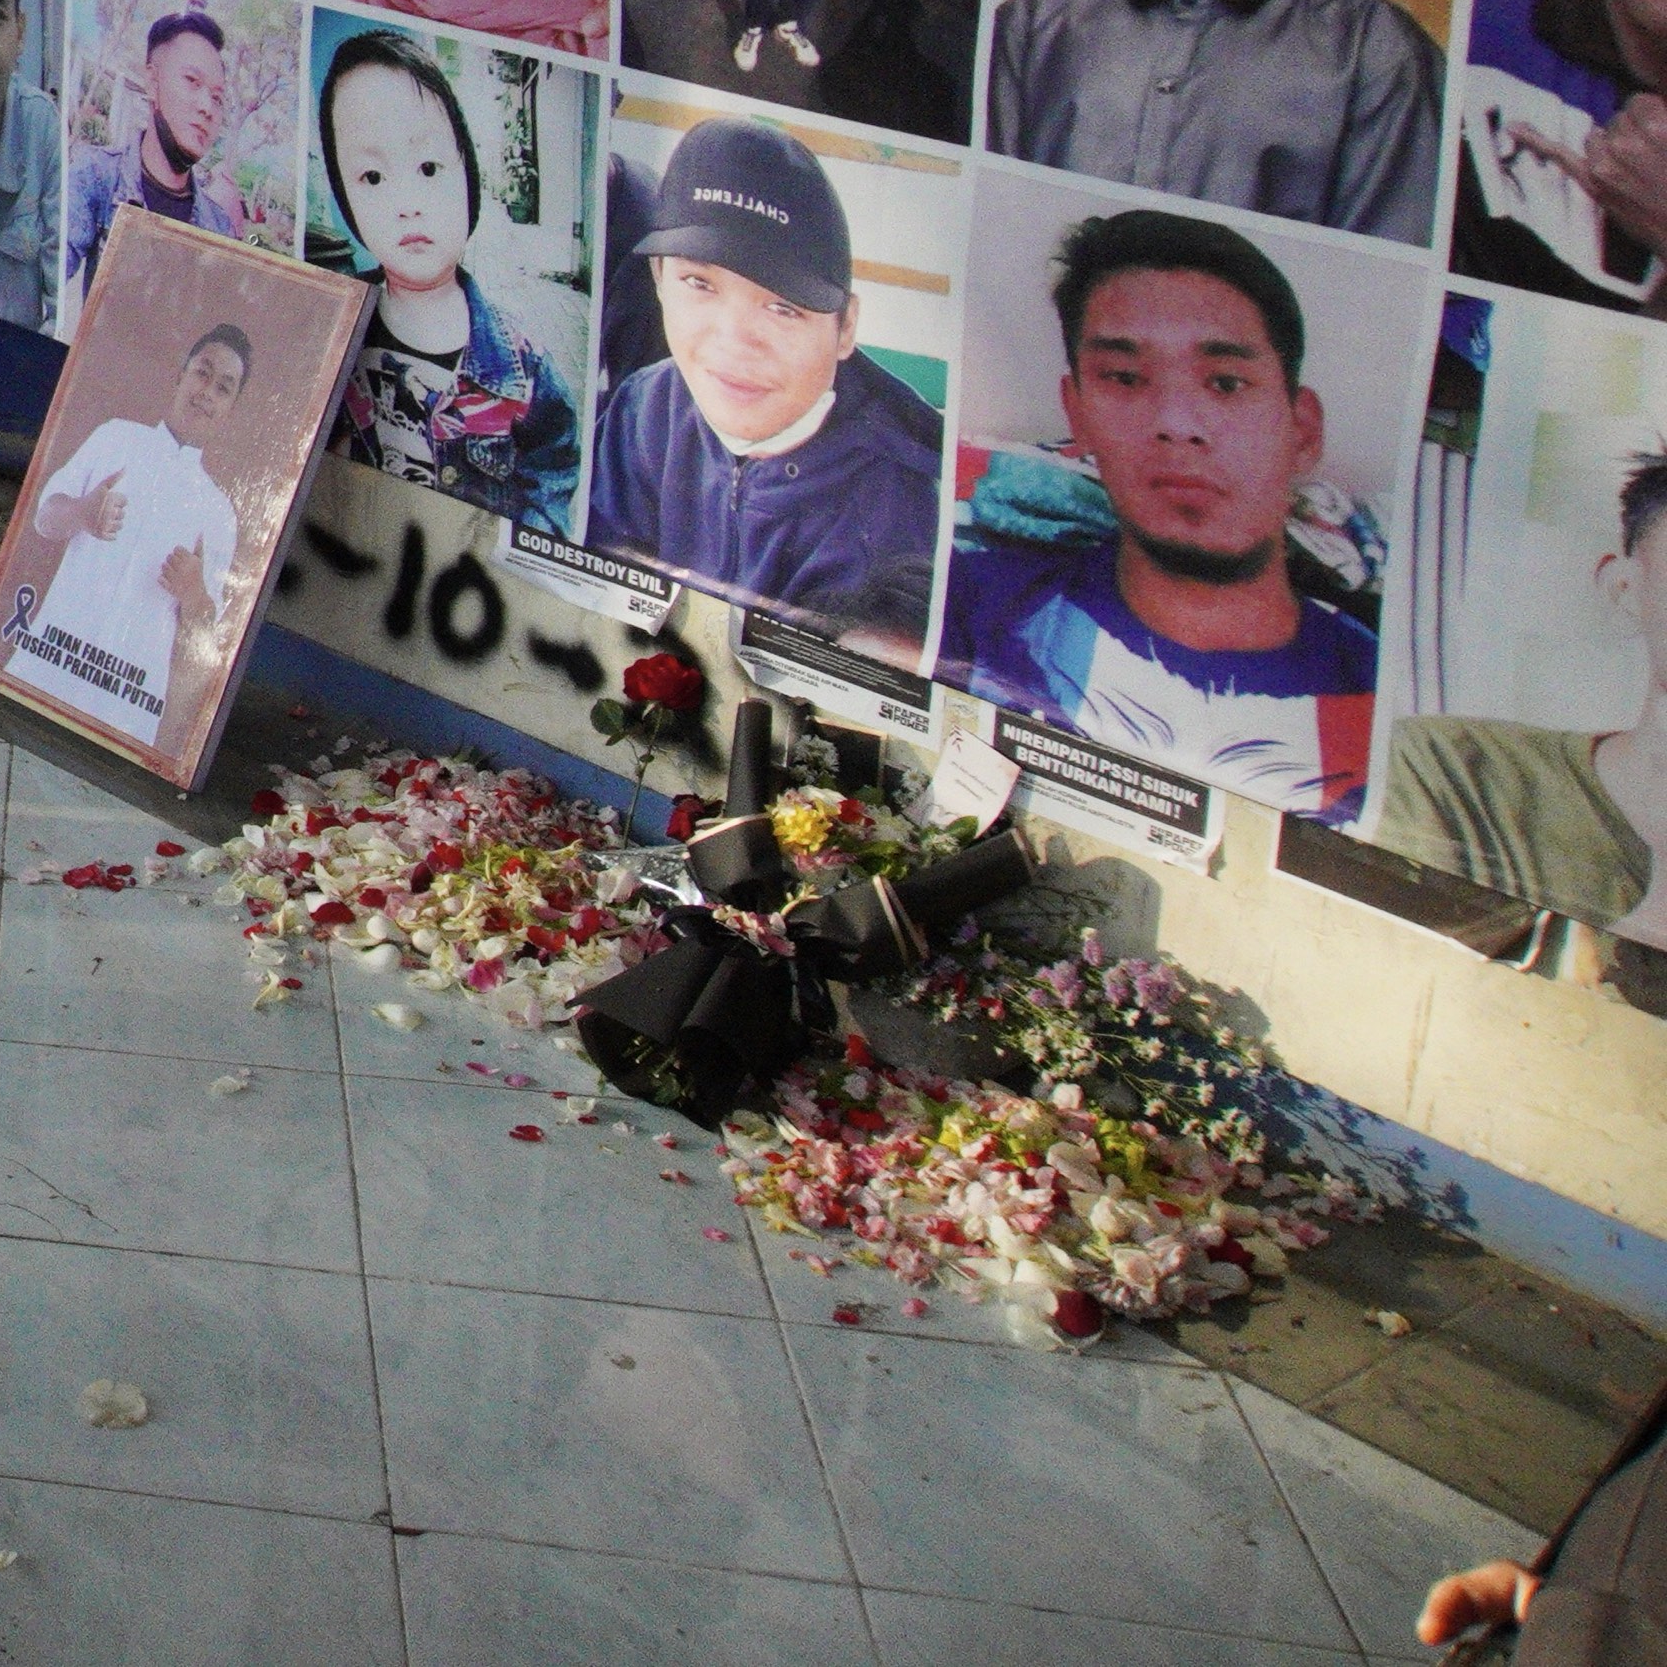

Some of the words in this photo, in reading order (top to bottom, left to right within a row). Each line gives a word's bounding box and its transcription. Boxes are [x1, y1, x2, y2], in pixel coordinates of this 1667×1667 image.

[518, 531, 553, 556] GOD
[553, 543, 628, 581] DESTROY
[628, 569, 666, 597] EVIL
[14, 629, 64, 667] YUSEIFA
[62, 654, 122, 697] PRATAMA
[121, 683, 166, 718] PUTRA
[42, 623, 83, 656] JOVAN
[80, 642, 147, 687] FARELLINO
[892, 714, 930, 735] POWER
[893, 706, 930, 726] PAPER
[1003, 723, 1098, 771] NIREMPATI
[1099, 757, 1139, 787] PSSI
[1140, 773, 1200, 809] SIBUK
[1017, 745, 1122, 798] BENTURKAN
[1124, 784, 1172, 817] KAMI
